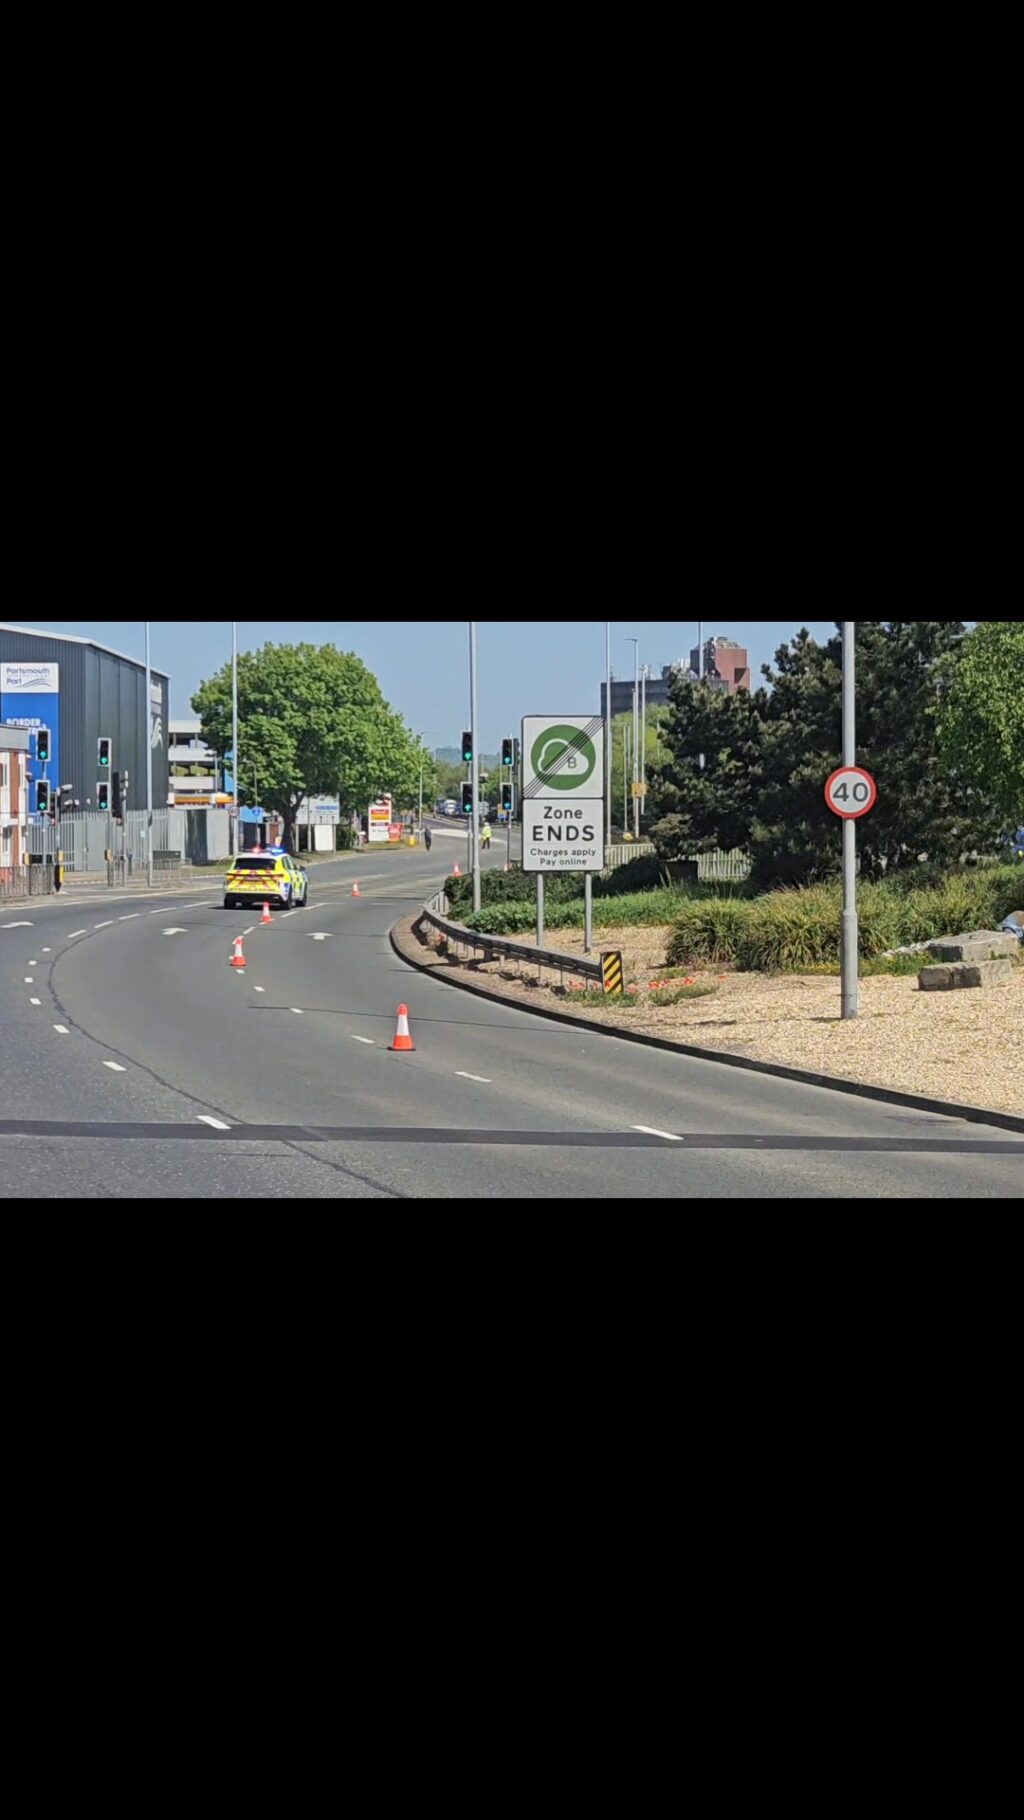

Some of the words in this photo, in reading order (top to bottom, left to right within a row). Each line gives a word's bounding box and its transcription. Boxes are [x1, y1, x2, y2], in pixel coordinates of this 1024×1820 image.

[6, 718, 41, 726] BORDER
[568, 757, 577, 769] B
[832, 782, 869, 802] 40
[543, 806, 583, 819] Zone
[532, 825, 594, 841] ENDS
[530, 848, 568, 857] Charges
[571, 848, 596, 856] apply
[540, 858, 557, 867] Pay
